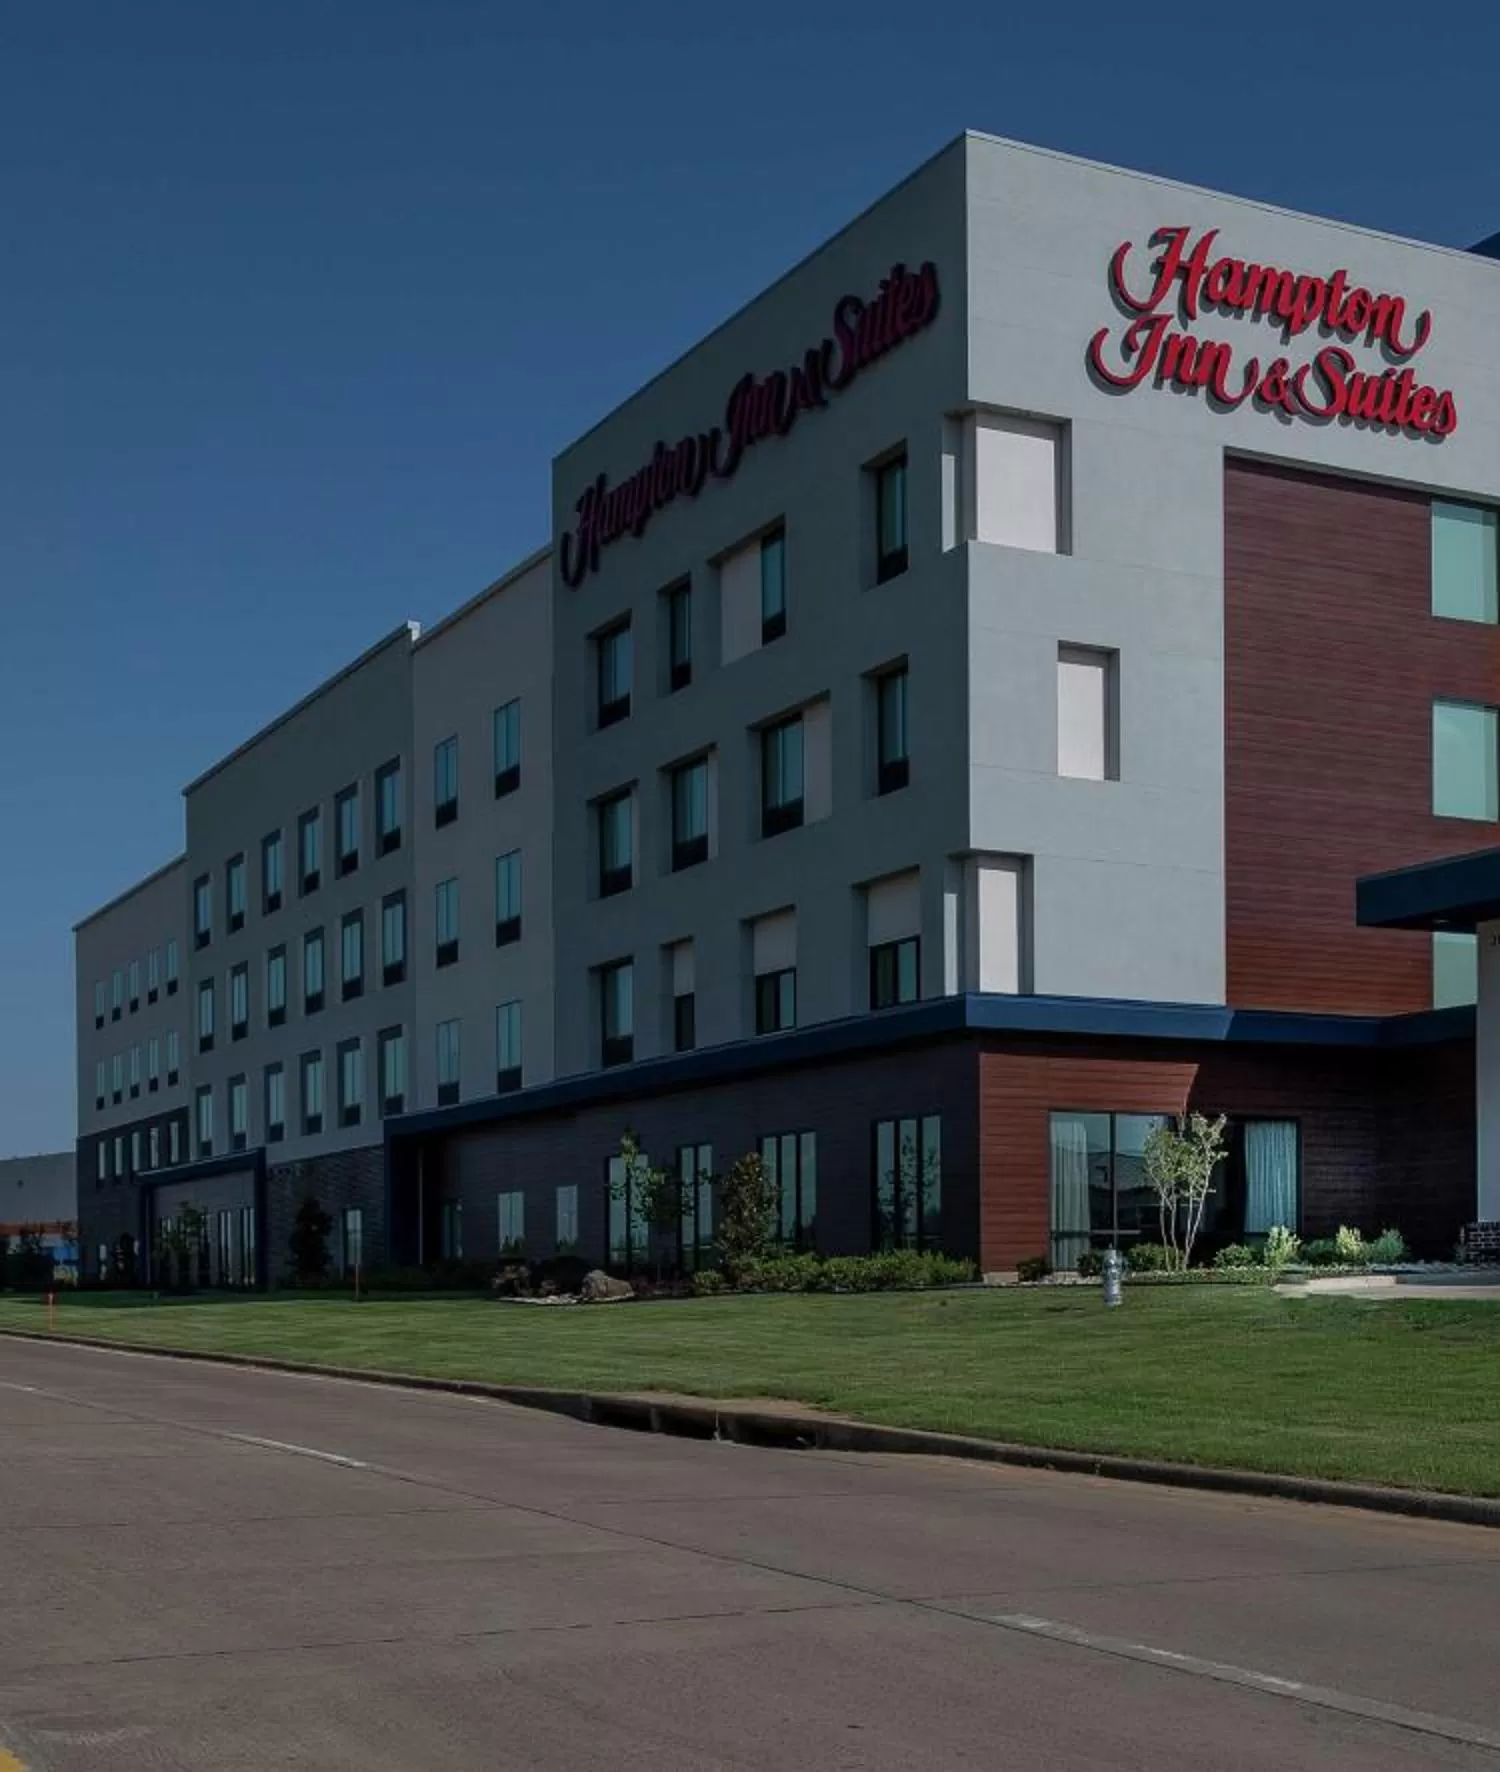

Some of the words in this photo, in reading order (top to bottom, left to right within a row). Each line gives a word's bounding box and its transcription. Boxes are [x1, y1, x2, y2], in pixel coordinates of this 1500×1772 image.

[1110, 226, 1431, 357] Hampton
[560, 433, 709, 588] Hampton
[709, 365, 802, 478] Inn
[820, 260, 941, 392] Suites
[1088, 314, 1260, 406] Inn
[1259, 357, 1303, 416] &
[1290, 345, 1458, 436] Suites
